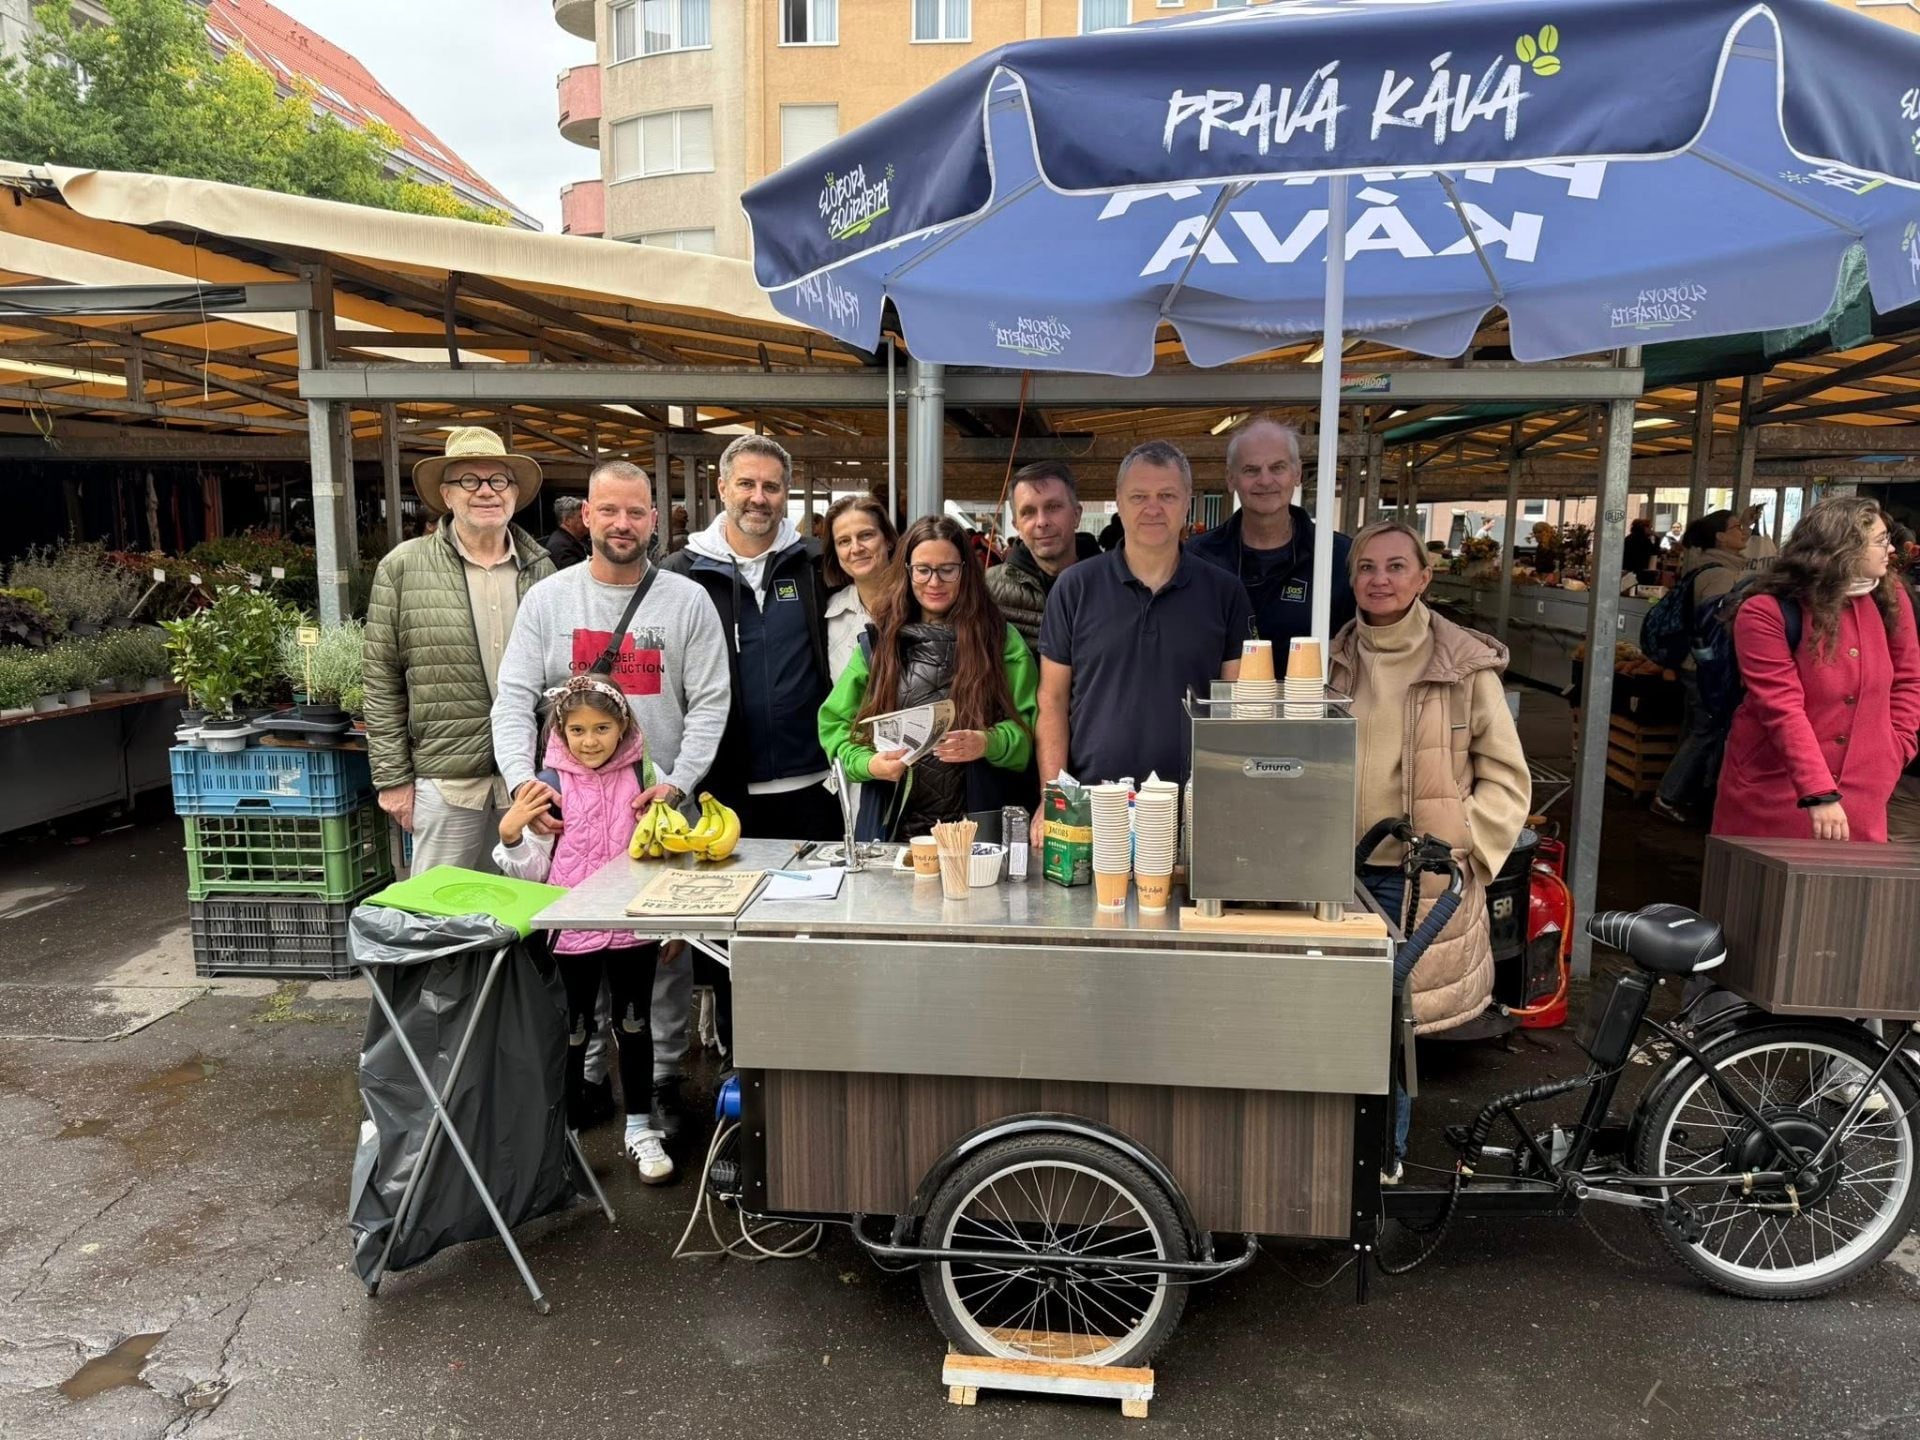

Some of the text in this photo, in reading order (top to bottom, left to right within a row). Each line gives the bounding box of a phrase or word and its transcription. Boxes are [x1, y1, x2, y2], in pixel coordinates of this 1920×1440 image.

[1163, 51, 1535, 155] PRAVÁ KÁVA
[1256, 761, 1291, 771] Futura
